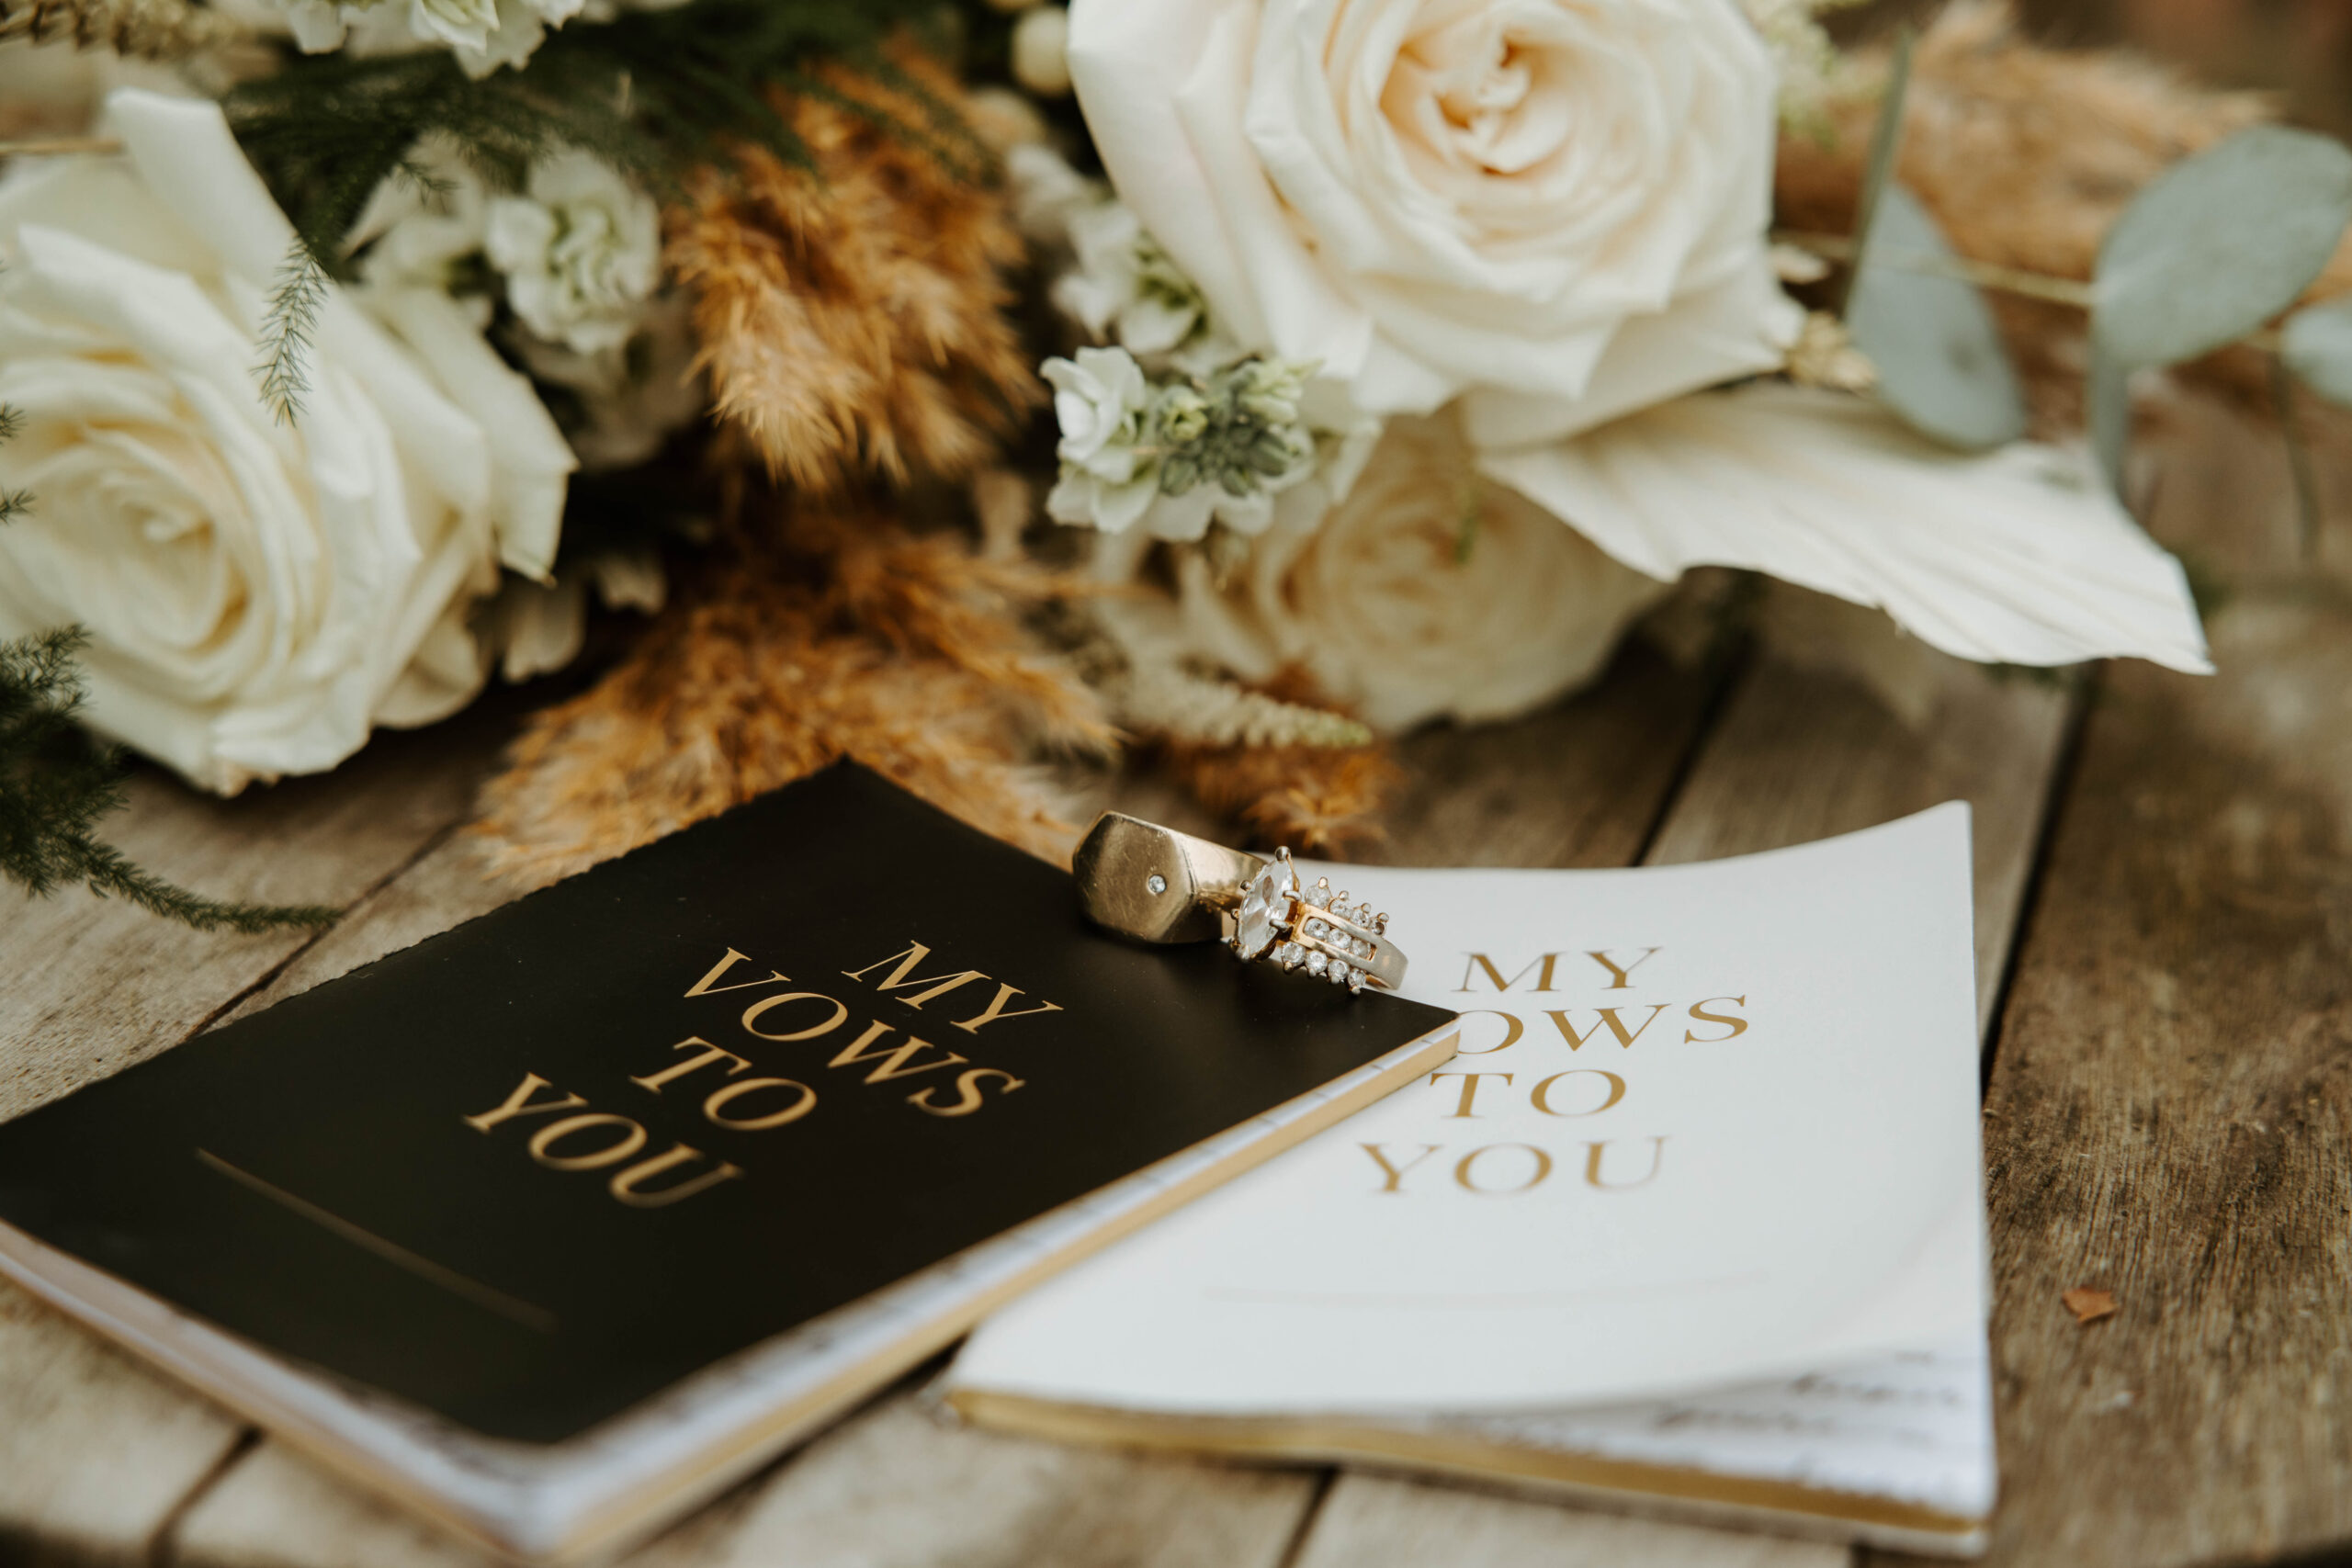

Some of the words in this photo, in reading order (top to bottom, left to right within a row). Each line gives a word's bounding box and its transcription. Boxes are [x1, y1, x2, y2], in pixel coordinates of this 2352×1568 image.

[841, 940, 1064, 1034] MY
[1451, 946, 1664, 993] MY
[684, 947, 1026, 1118] VOWS
[1457, 995, 1749, 1055] OWS
[628, 1036, 817, 1132] TO
[1430, 1068, 1626, 1119] TO
[462, 1072, 743, 1209] YOU
[1358, 1135, 1671, 1195] YOU
